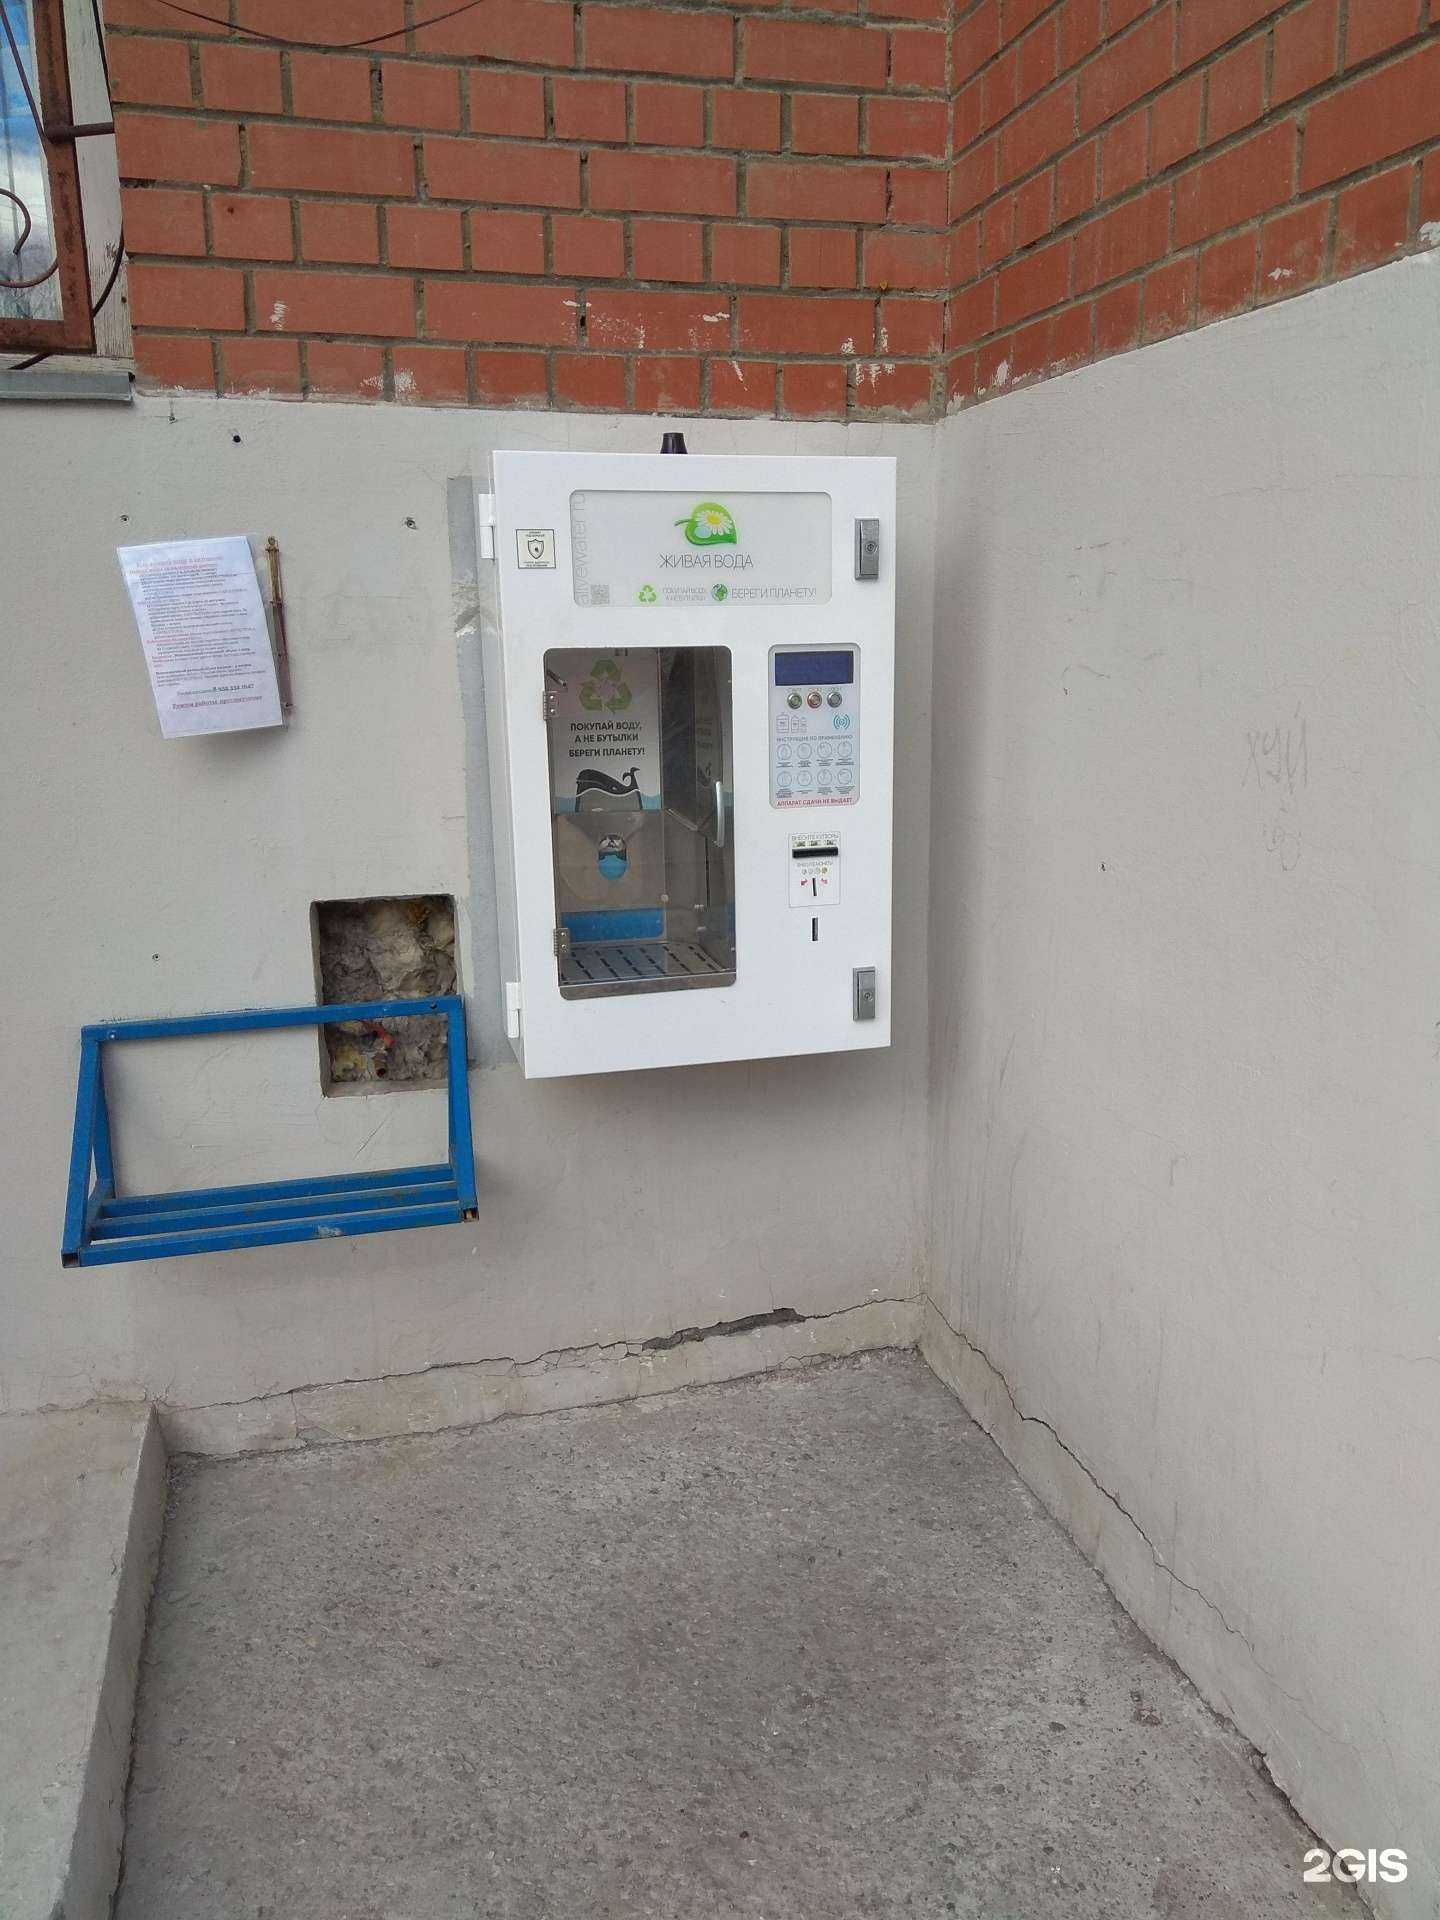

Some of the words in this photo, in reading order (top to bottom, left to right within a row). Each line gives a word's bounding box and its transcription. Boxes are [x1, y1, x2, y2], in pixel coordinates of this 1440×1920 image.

[658, 553, 711, 569] ЖИВАЯ
[714, 553, 753, 570] ВОДА
[731, 588, 769, 599] БЕРЕГИ
[570, 720, 613, 731] ПОКУПАЙ
[616, 721, 642, 731] ВОДУ,
[575, 735, 581, 743] А
[584, 734, 595, 742] НЕ
[597, 733, 638, 742] БУТЫЛКИ
[569, 748, 600, 757] БЕРЕГИ
[602, 747, 645, 756] ПЛАНЕТУ!
